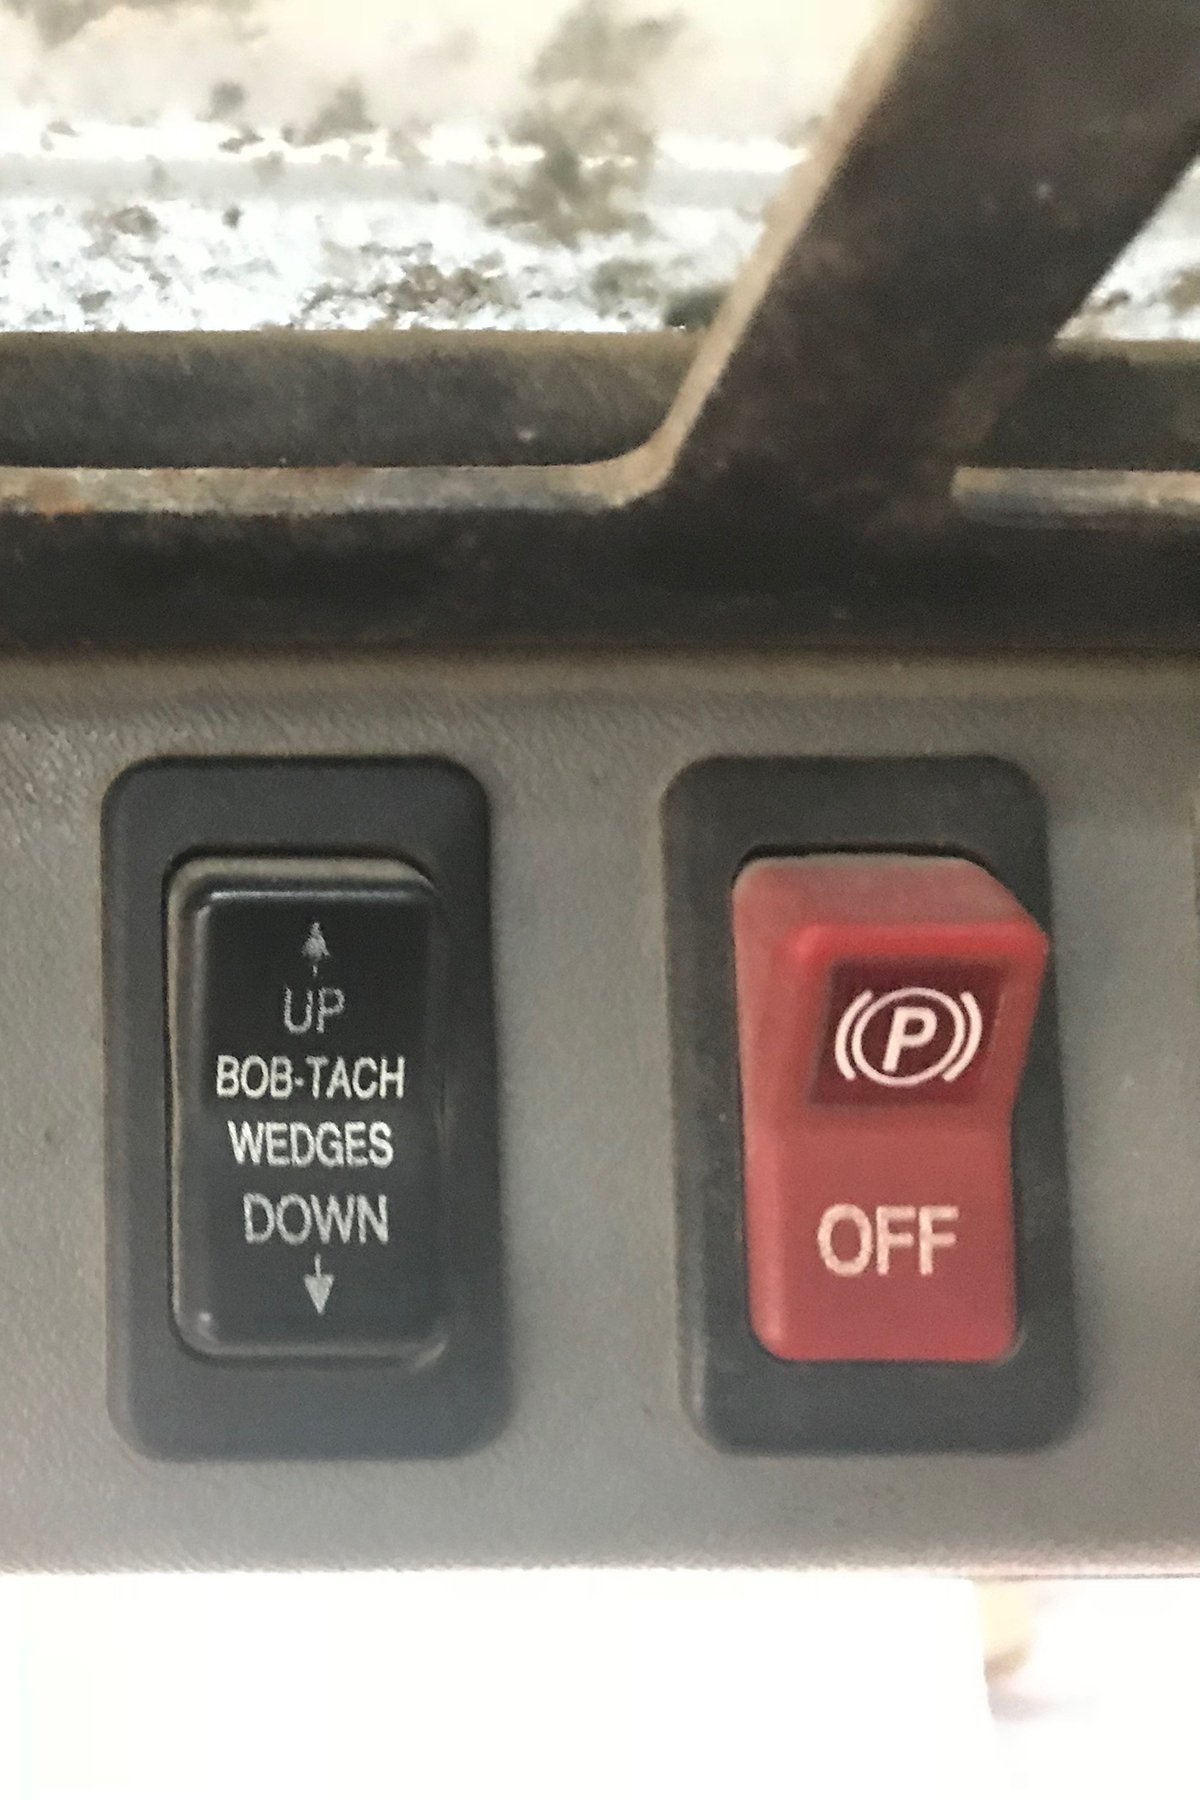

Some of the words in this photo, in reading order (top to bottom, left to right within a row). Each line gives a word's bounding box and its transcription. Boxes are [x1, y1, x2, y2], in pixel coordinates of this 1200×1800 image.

[283, 984, 345, 1034] UP
[216, 1055, 405, 1099] BOB-TACH
[227, 1121, 395, 1168] WEDGES
[243, 1192, 390, 1245] DOWN
[817, 1203, 959, 1277] OFF
